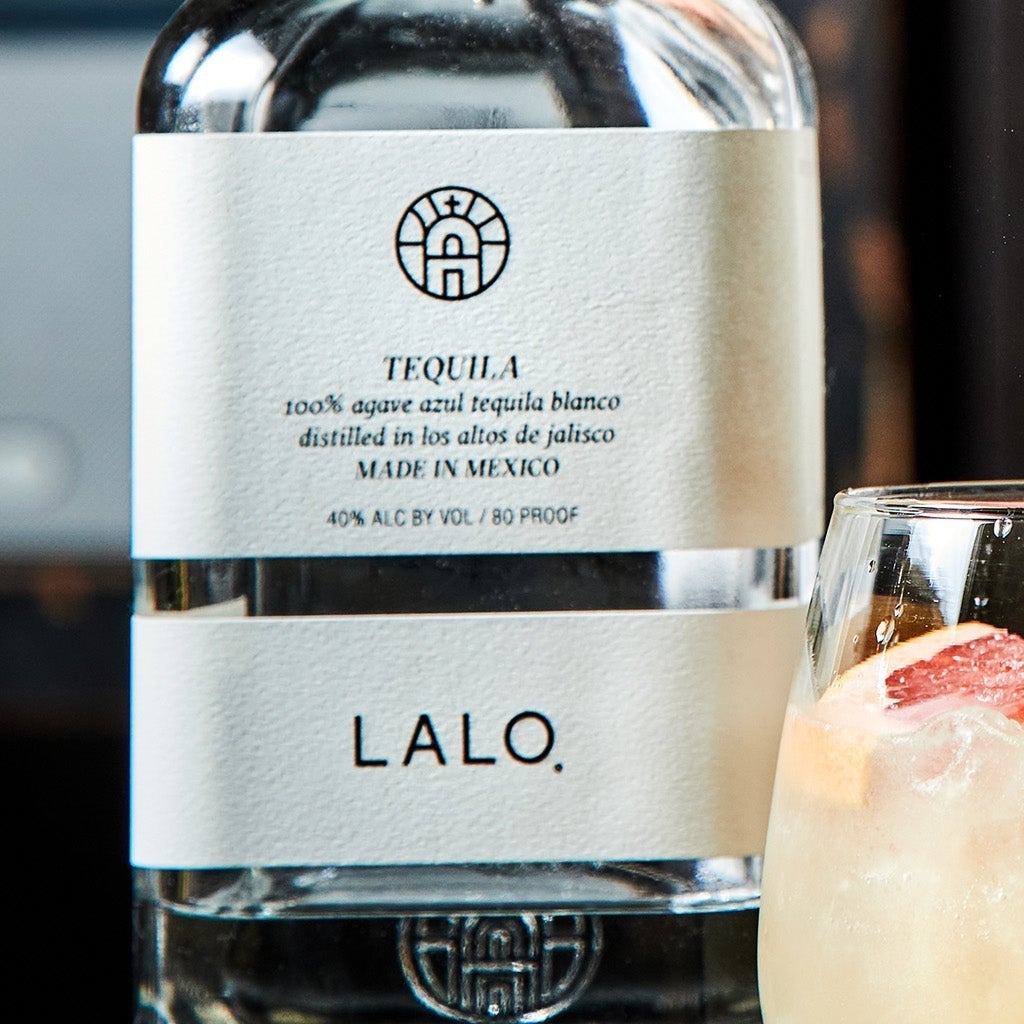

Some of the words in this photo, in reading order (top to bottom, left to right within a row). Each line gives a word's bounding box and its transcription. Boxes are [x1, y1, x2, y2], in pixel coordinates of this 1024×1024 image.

[383, 354, 519, 386] TEQUILA
[351, 399, 413, 420] agave
[419, 391, 464, 414] azul
[471, 390, 544, 418] tequila
[550, 390, 621, 412] blanco
[298, 425, 386, 448] distilled
[393, 425, 414, 447] in
[421, 425, 451, 446] los
[457, 424, 508, 446] altos
[515, 423, 540, 445] de
[544, 422, 616, 450] jalisco
[357, 459, 427, 480] MADE
[433, 459, 457, 479] IN
[467, 457, 560, 478] MEXICO
[326, 509, 365, 528] 40%
[371, 508, 406, 528] ALC
[411, 508, 433, 527] BY
[439, 508, 473, 527] VOL
[478, 507, 487, 525] /
[491, 508, 515, 526] 80
[520, 506, 578, 525] PROOF
